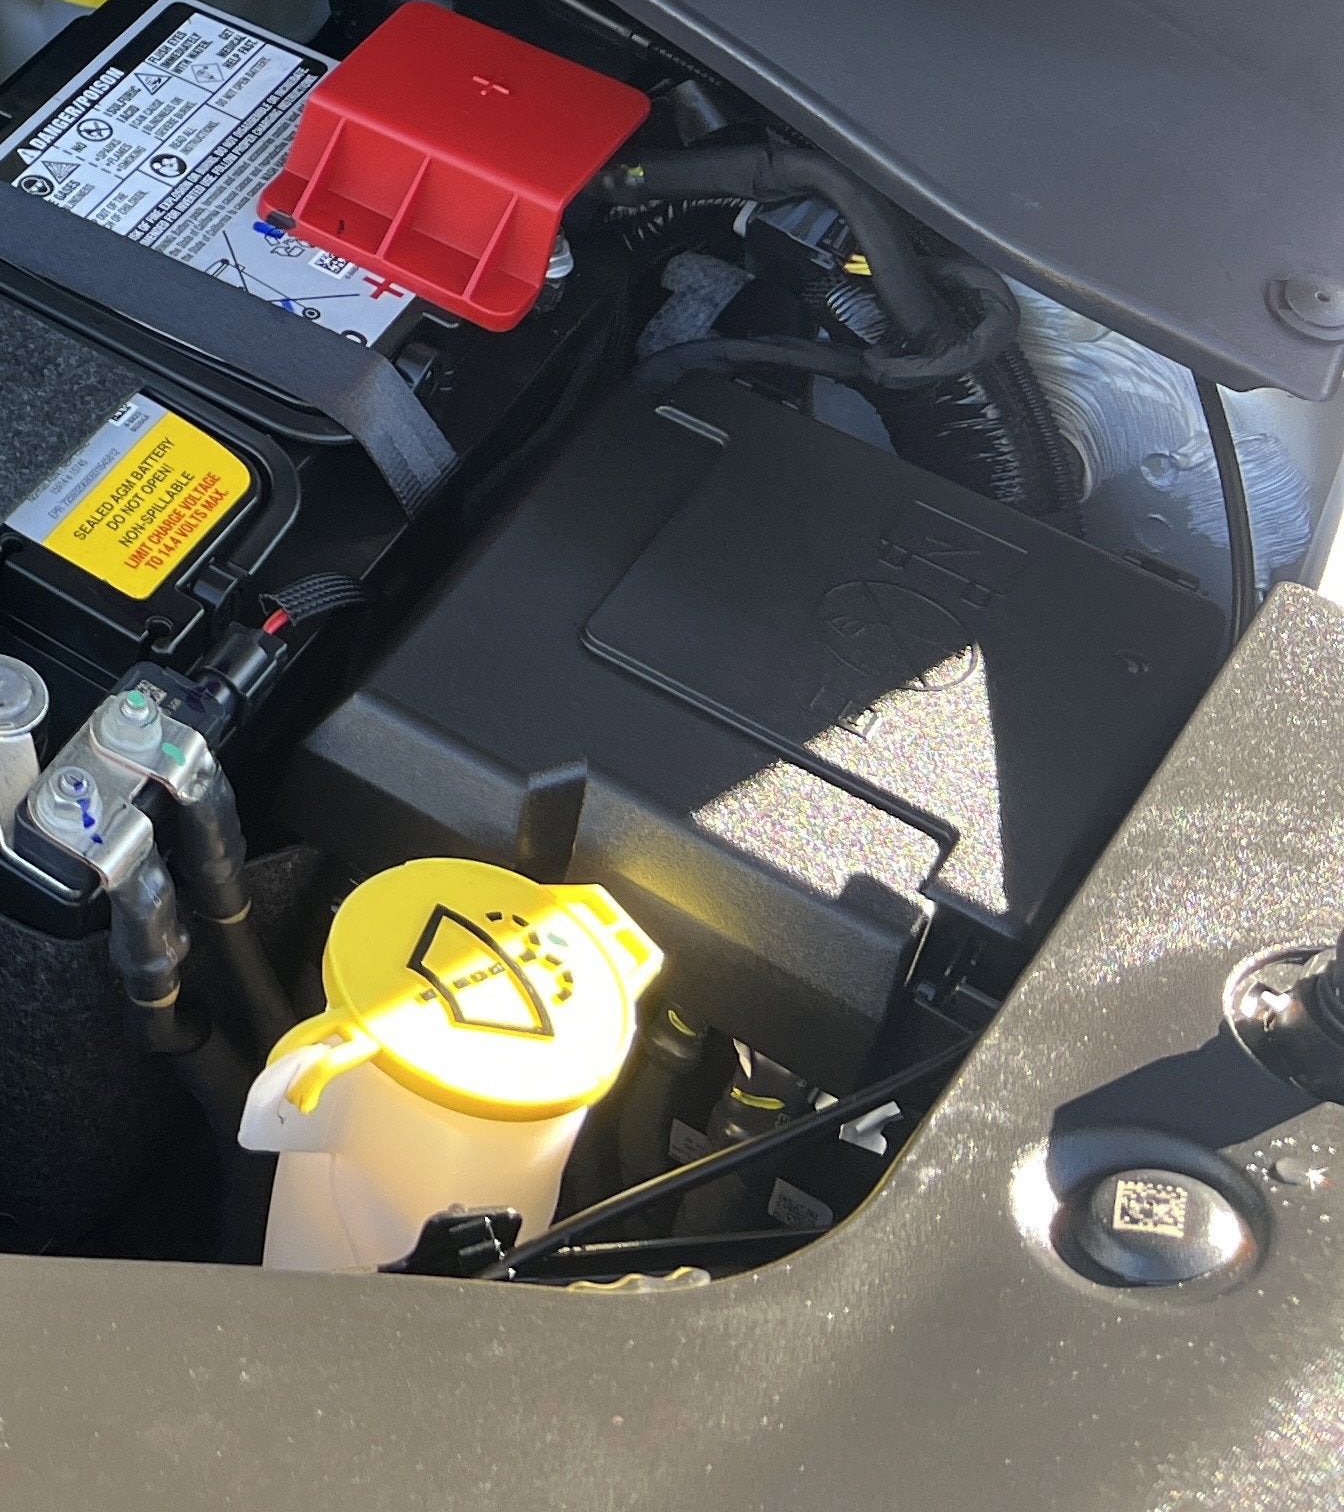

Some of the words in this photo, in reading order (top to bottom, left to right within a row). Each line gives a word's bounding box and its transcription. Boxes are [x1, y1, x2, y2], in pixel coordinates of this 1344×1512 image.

[217, 27, 235, 40] GET
[147, 44, 172, 63] FLUSH
[165, 30, 187, 46] EYES
[215, 33, 247, 58] MEDICAL
[170, 58, 192, 74] WITH
[221, 52, 243, 69] HELP
[231, 75, 251, 90] OPEN
[27, 65, 125, 149] DANGER/POISON
[105, 85, 142, 114] SULFURIC
[141, 98, 164, 115] CAUSE
[118, 104, 140, 120] ACID
[142, 103, 176, 131] BLINDNESS
[153, 117, 179, 137] SEVERE
[70, 141, 87, 152] NO
[167, 134, 188, 150] READ
[52, 179, 81, 201] GASES
[71, 499, 116, 541] SEALED
[107, 477, 137, 504] AGM
[128, 436, 176, 481] BATTERY
[104, 512, 127, 531] DO
[119, 492, 146, 516] NOT
[139, 461, 175, 496] OPEN!
[117, 468, 195, 549] NON-SPILLABLE
[123, 541, 155, 570] LIMIT
[146, 507, 186, 546] CHARGE
[177, 469, 221, 513] VOLTAGE
[143, 553, 165, 572] TO
[156, 534, 183, 558] 14.4
[174, 506, 208, 540] VOLTS
